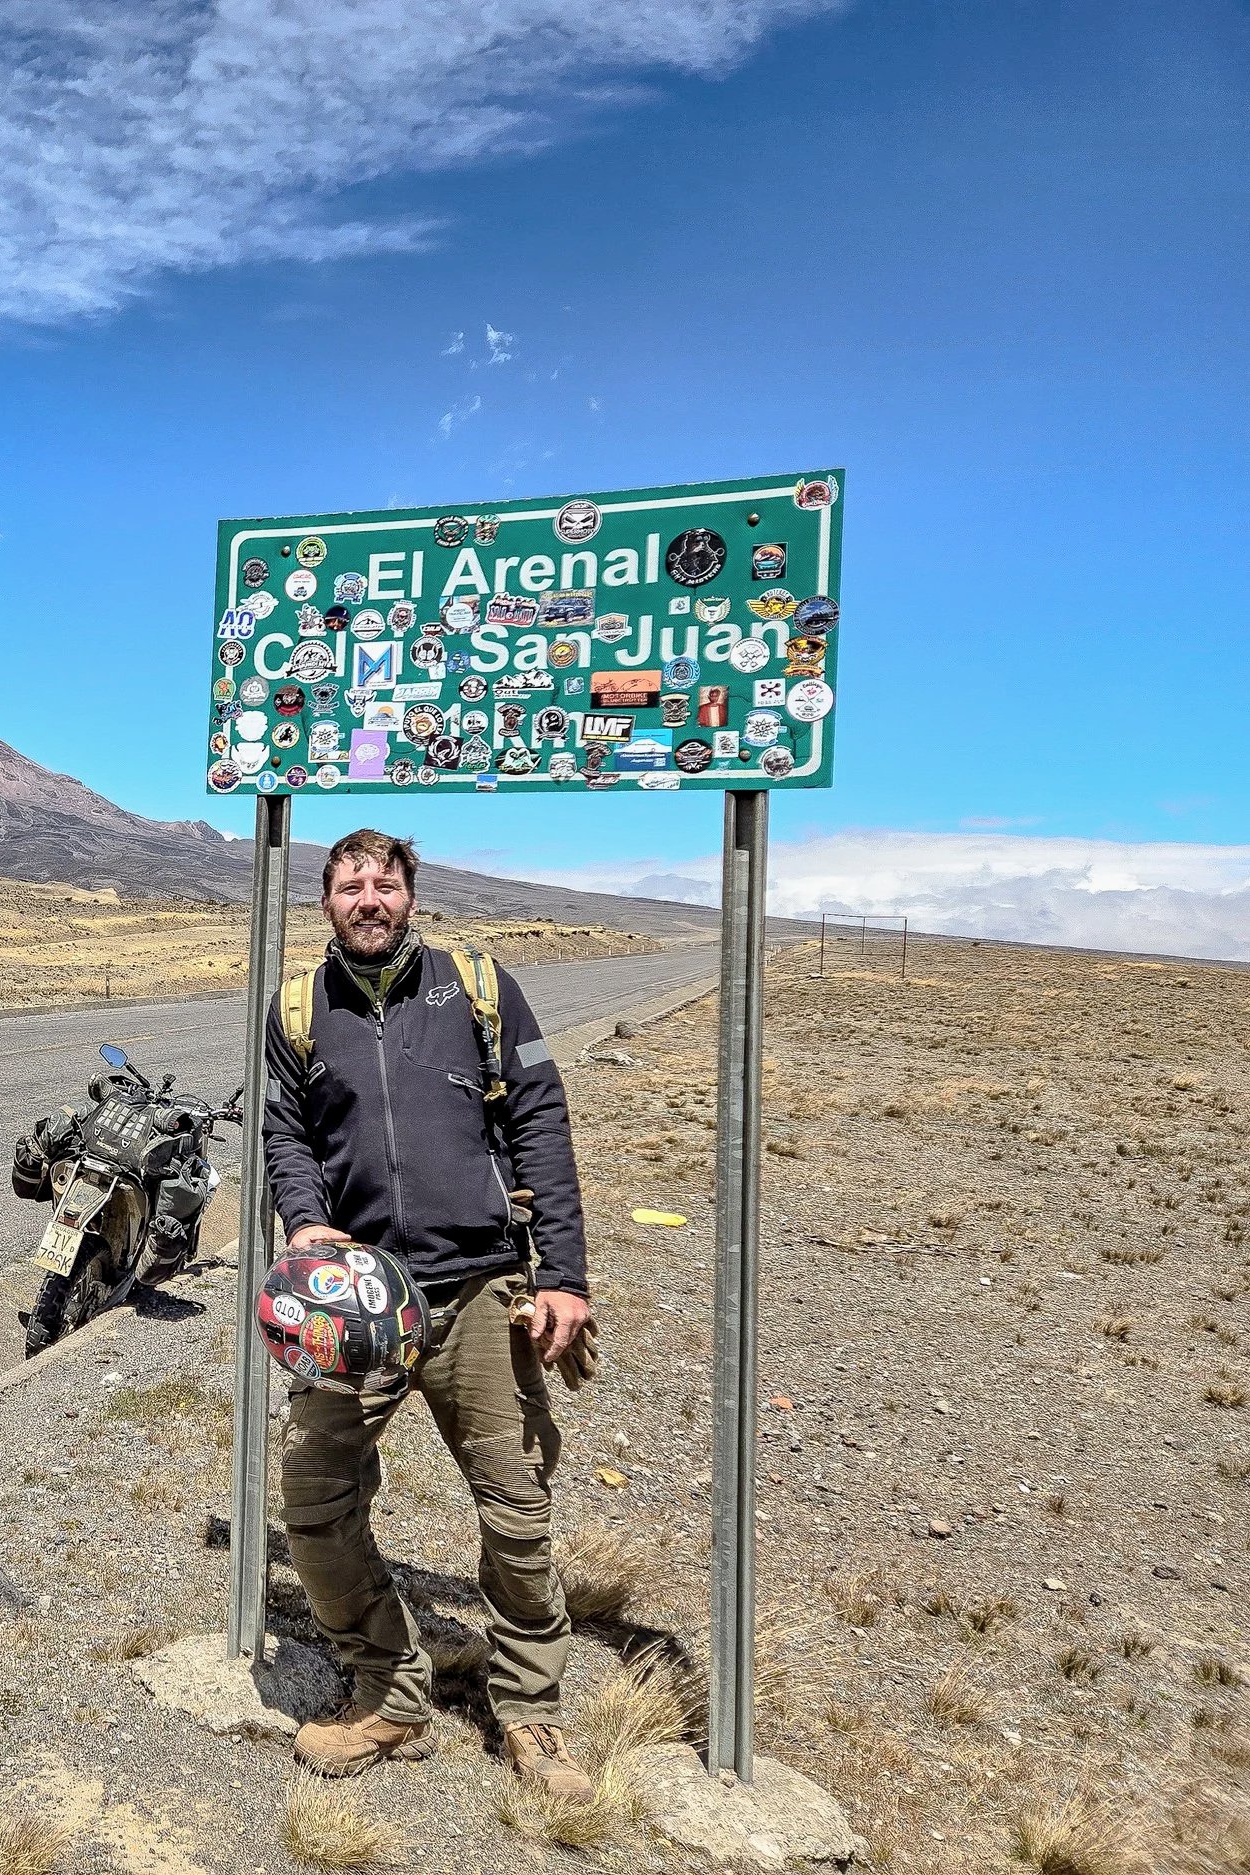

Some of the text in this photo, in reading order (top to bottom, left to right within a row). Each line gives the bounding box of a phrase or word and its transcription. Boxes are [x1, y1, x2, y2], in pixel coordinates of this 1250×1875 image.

[368, 533, 660, 600] El Arenal
[470, 624, 592, 673] San
[614, 614, 790, 668] Juan
[51, 1223, 78, 1237] ECUADOR
[363, 1278, 376, 1308] IMOGENE
